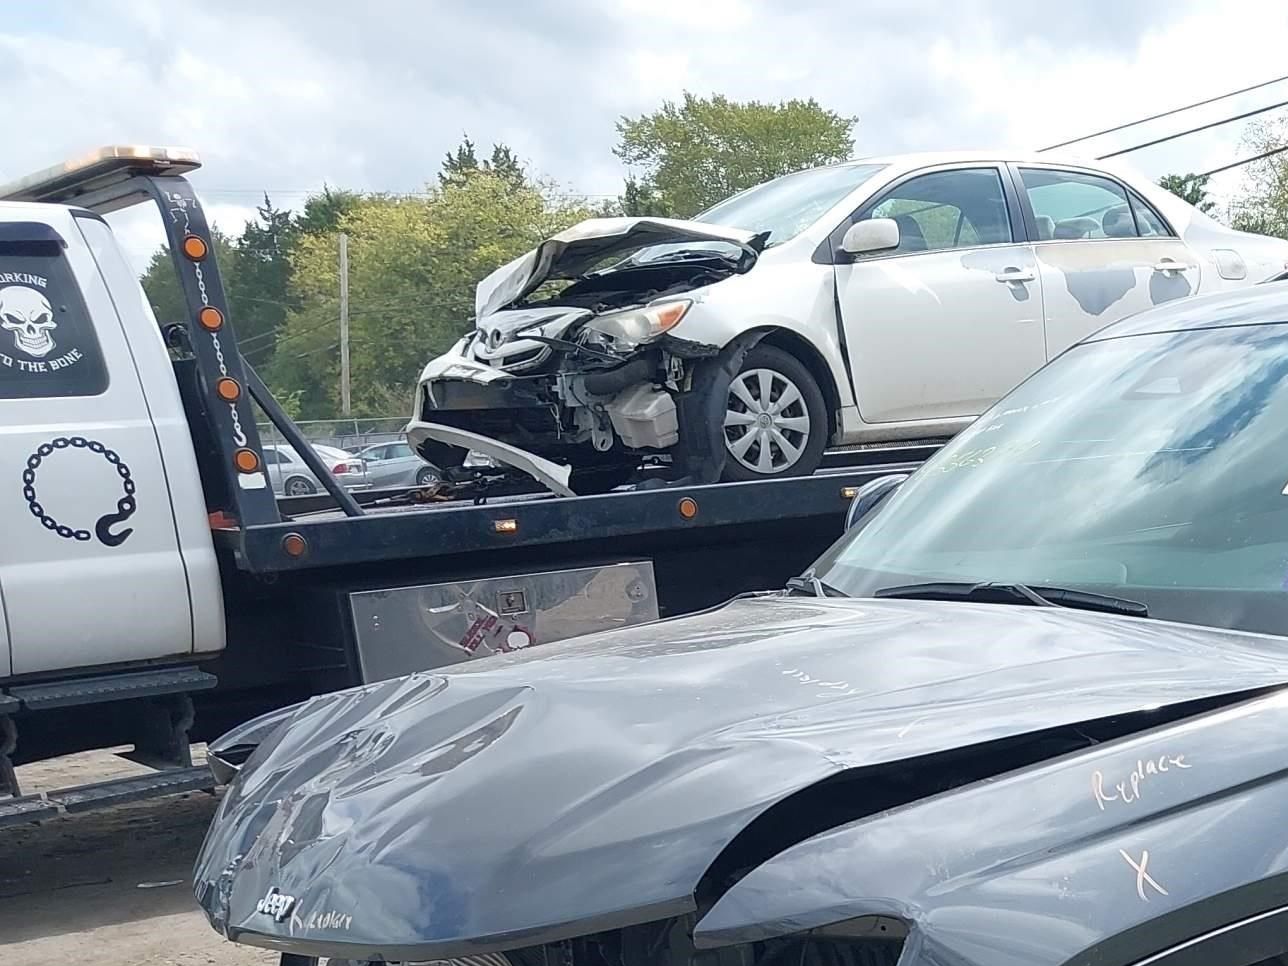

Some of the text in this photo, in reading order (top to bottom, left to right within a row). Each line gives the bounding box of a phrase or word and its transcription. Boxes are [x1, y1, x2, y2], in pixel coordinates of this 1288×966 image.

[17, 359, 48, 373] THE
[49, 347, 83, 371] BONE
[256, 886, 295, 921] Jeep
